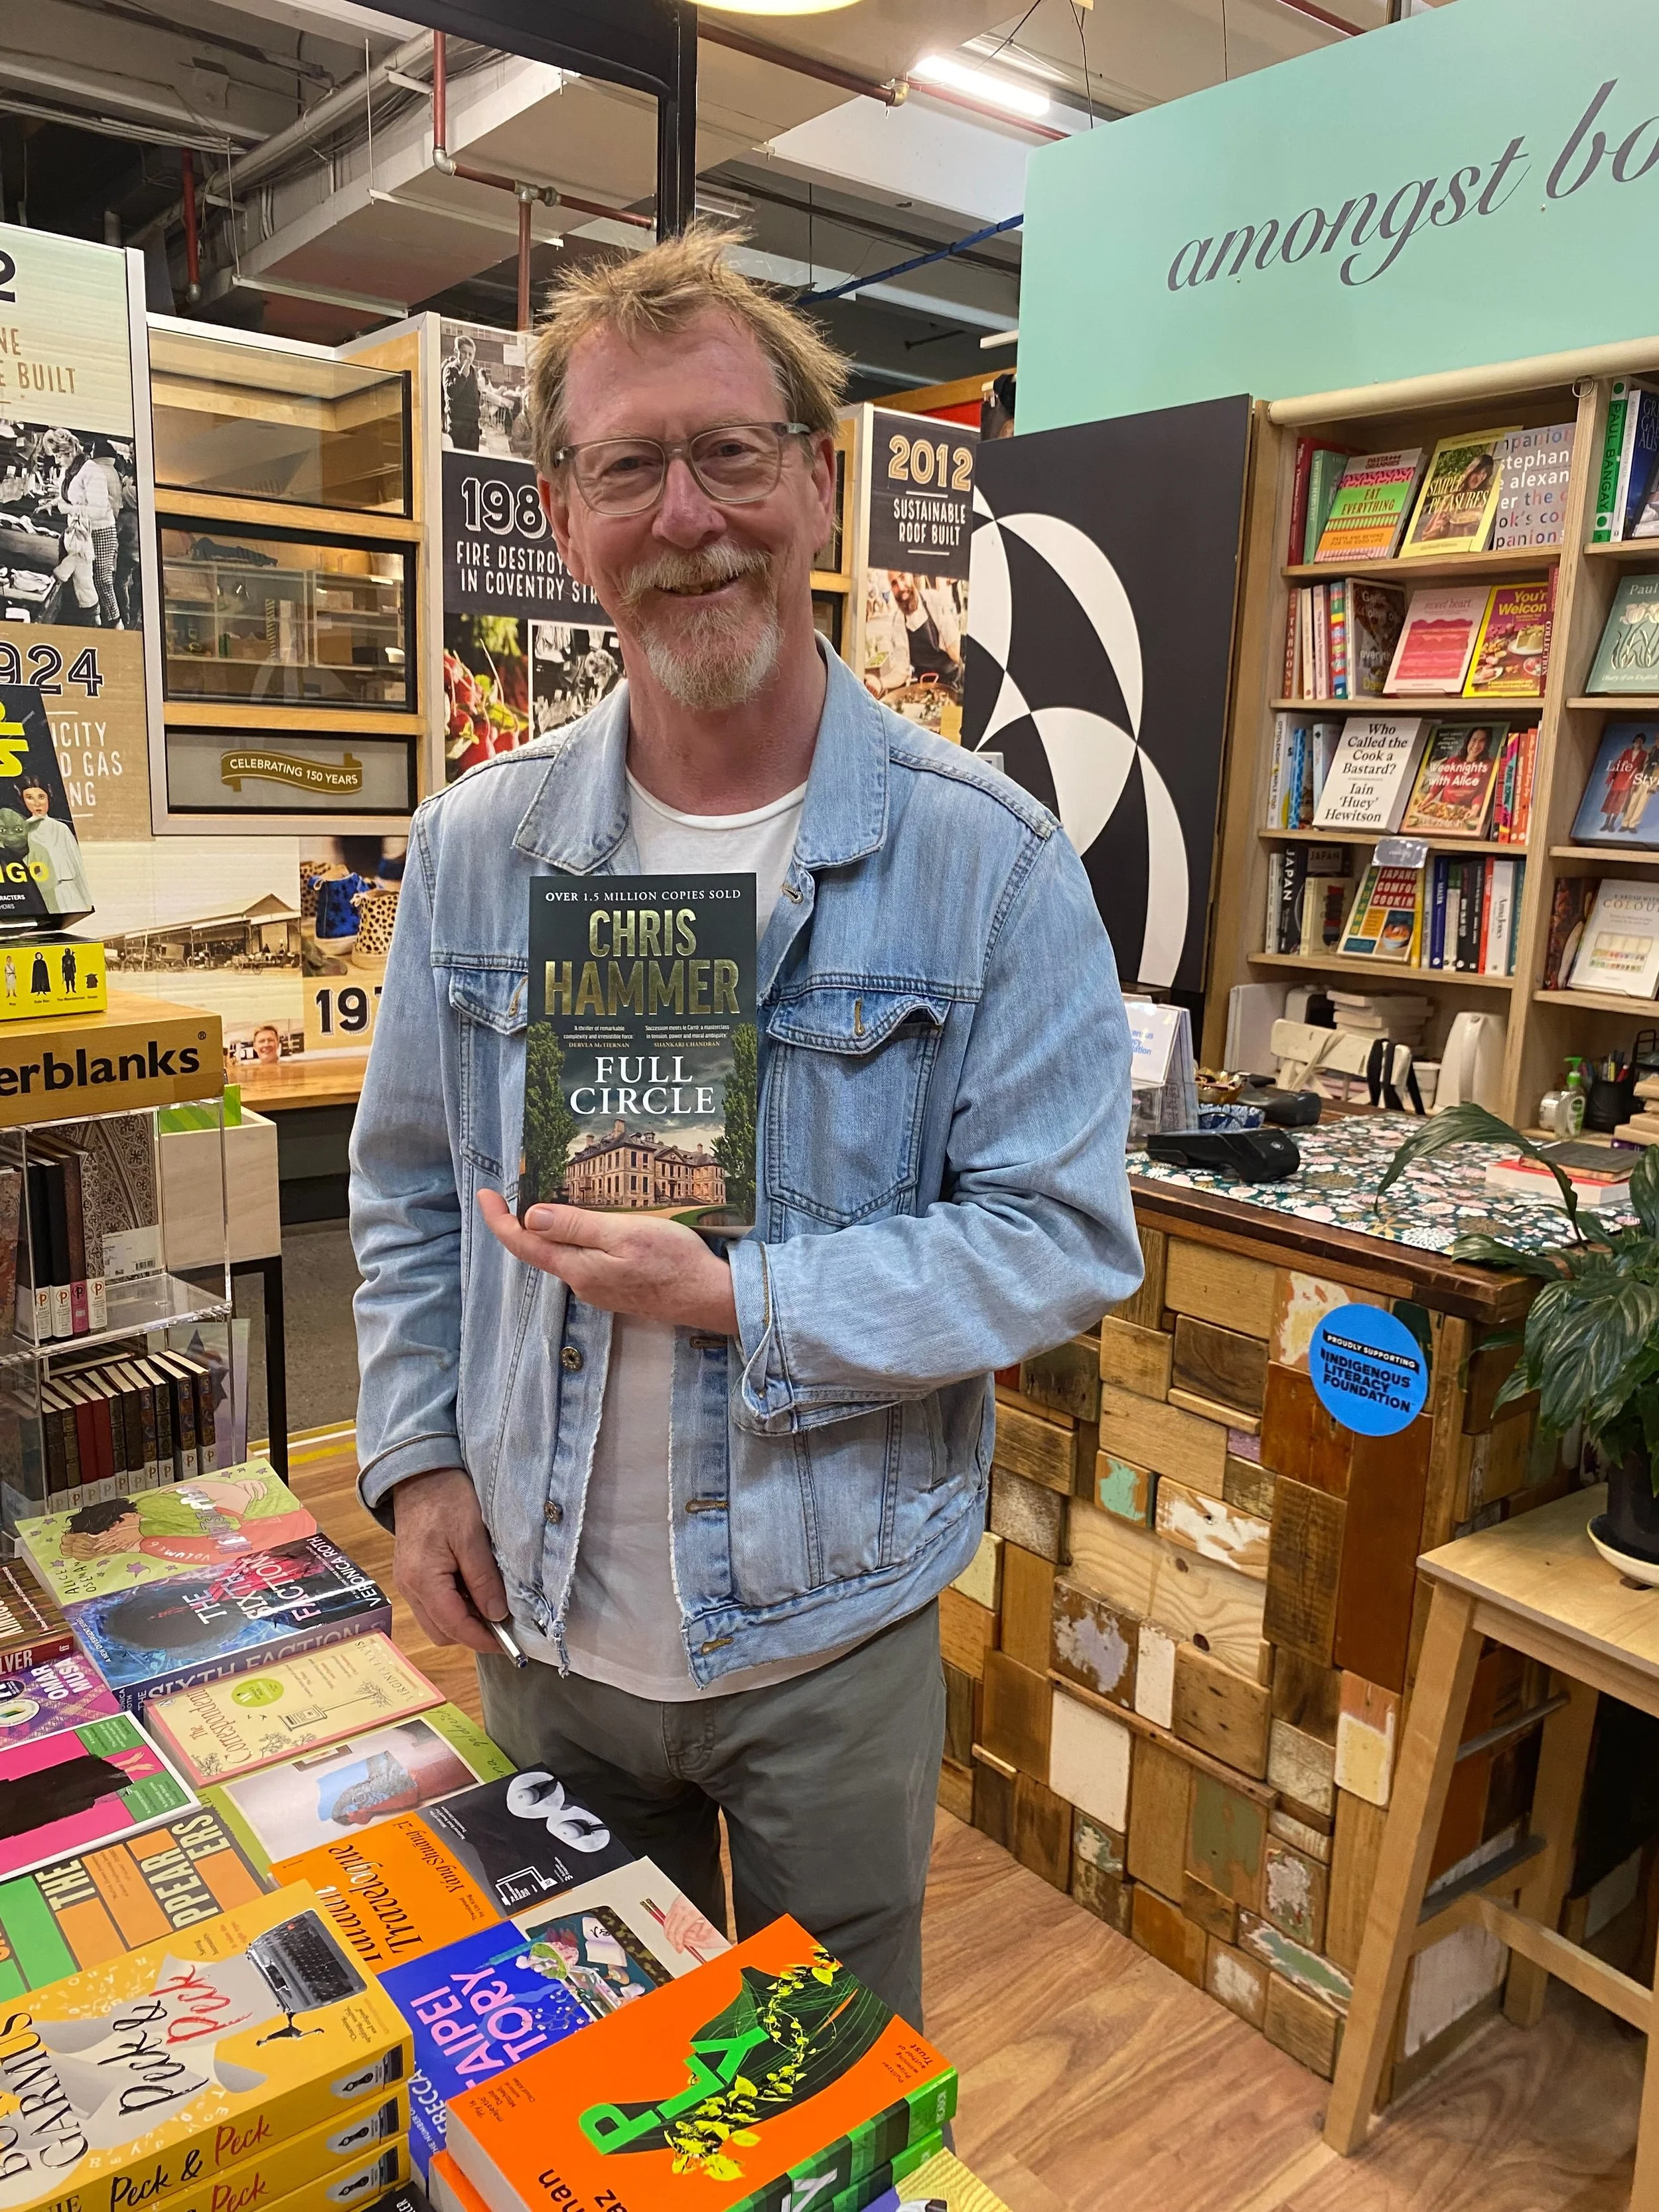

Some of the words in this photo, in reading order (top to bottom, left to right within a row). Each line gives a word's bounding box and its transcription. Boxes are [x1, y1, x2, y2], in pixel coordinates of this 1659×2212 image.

[1167, 135, 1532, 286] amongst
[17, 362, 76, 394] BUILT
[1607, 404, 1621, 443] PAUL
[888, 434, 973, 491] 2012
[1364, 488, 1382, 500] EAT
[1427, 475, 1465, 496] SIMPLE
[1599, 449, 1616, 510] BANGAY
[894, 498, 966, 525] SUSTAINABLE
[1341, 499, 1396, 516] EVERYTHING
[1428, 490, 1490, 515] PLEASURES
[899, 522, 926, 544] ROOF
[932, 525, 960, 546] BUILT
[457, 541, 490, 567] FIRE
[498, 546, 572, 576] DESTROY
[461, 569, 477, 592] IN
[486, 571, 564, 601] COVENTRY
[1630, 583, 1658, 595] Paul
[1348, 737, 1385, 748] Called
[1389, 737, 1407, 748] the
[1369, 723, 1396, 735] Who
[82, 751, 123, 776] GAS
[230, 759, 303, 777] CELEBRATING
[306, 770, 323, 782] 150
[325, 773, 358, 784] YEARS
[1342, 763, 1396, 774] Bastard?
[1353, 750, 1383, 761] Cook
[1429, 762, 1488, 774] Weeknights
[1350, 783, 1373, 794] Iain
[1429, 776, 1451, 786] with
[1452, 776, 1479, 786] Alice
[1325, 808, 1381, 822] Hewitson
[1340, 796, 1378, 810] 'Huey'
[1310, 851, 1340, 860] JAPAN
[1283, 849, 1295, 901] JAPAN
[545, 891, 579, 902] OVER
[583, 891, 600, 902] 1.5
[604, 891, 658, 901] MILLION
[661, 890, 705, 901] COPIES
[709, 889, 741, 899] SOLD
[589, 909, 697, 957] CHRIS
[545, 959, 740, 1015] HAMMER
[316, 984, 383, 1037] 19
[0, 1041, 200, 1094] erblanks
[595, 1056, 693, 1083] FULL
[569, 1087, 716, 1115] CIRCLE
[1327, 1335, 1362, 1351] PROUDLY
[1363, 1347, 1415, 1368] SUPPORTING
[1325, 1351, 1411, 1388] INDIGENOUS
[1325, 1363, 1389, 1393] LITERACY
[1323, 1372, 1411, 1413] FOUNDATION
[147, 1540, 159, 1549] 6
[159, 1544, 210, 1562] VOLUME
[307, 1536, 337, 1558] ROTH
[56, 1570, 80, 1594] ALICE
[74, 1561, 97, 1593] OSEMAN
[242, 1552, 322, 1621] FACTION
[332, 1556, 382, 1607] VERONICA
[182, 1589, 227, 1625] THE
[221, 1569, 267, 1620] SIXTH
[31, 1664, 68, 1700] OMAR
[55, 1657, 93, 1694] MUSA
[379, 1666, 415, 1702] VIRGINIA
[138, 1690, 147, 1710] THE
[186, 1689, 253, 1764] Correspondent
[190, 1725, 208, 1741] The
[172, 1814, 232, 1860] ERS
[35, 1860, 96, 1911] THE
[141, 1847, 219, 1928] PPEAR
[435, 1866, 465, 1893] Yáng
[328, 1844, 423, 1954] Travelogue
[459, 1897, 476, 1921] Translated
[148, 1964, 253, 2045] Peck
[450, 1967, 547, 2063] TORY
[410, 1986, 505, 2089] AIPEI
[895, 2051, 918, 2074] winning
[905, 2050, 926, 2069] author
[910, 2043, 932, 2065] Trust
[98, 2030, 210, 2117] Peck
[881, 2061, 904, 2083] Pulitzer
[0, 2012, 88, 2169] GARMUS
[488, 2090, 503, 2105] David
[579, 2027, 770, 2155] PLY
[413, 2112, 432, 2145] NUMBER
[110, 2166, 172, 2212] Peck
[180, 2150, 203, 2180] &
[215, 2115, 273, 2166] Peck
[211, 2173, 267, 2212] Peck
